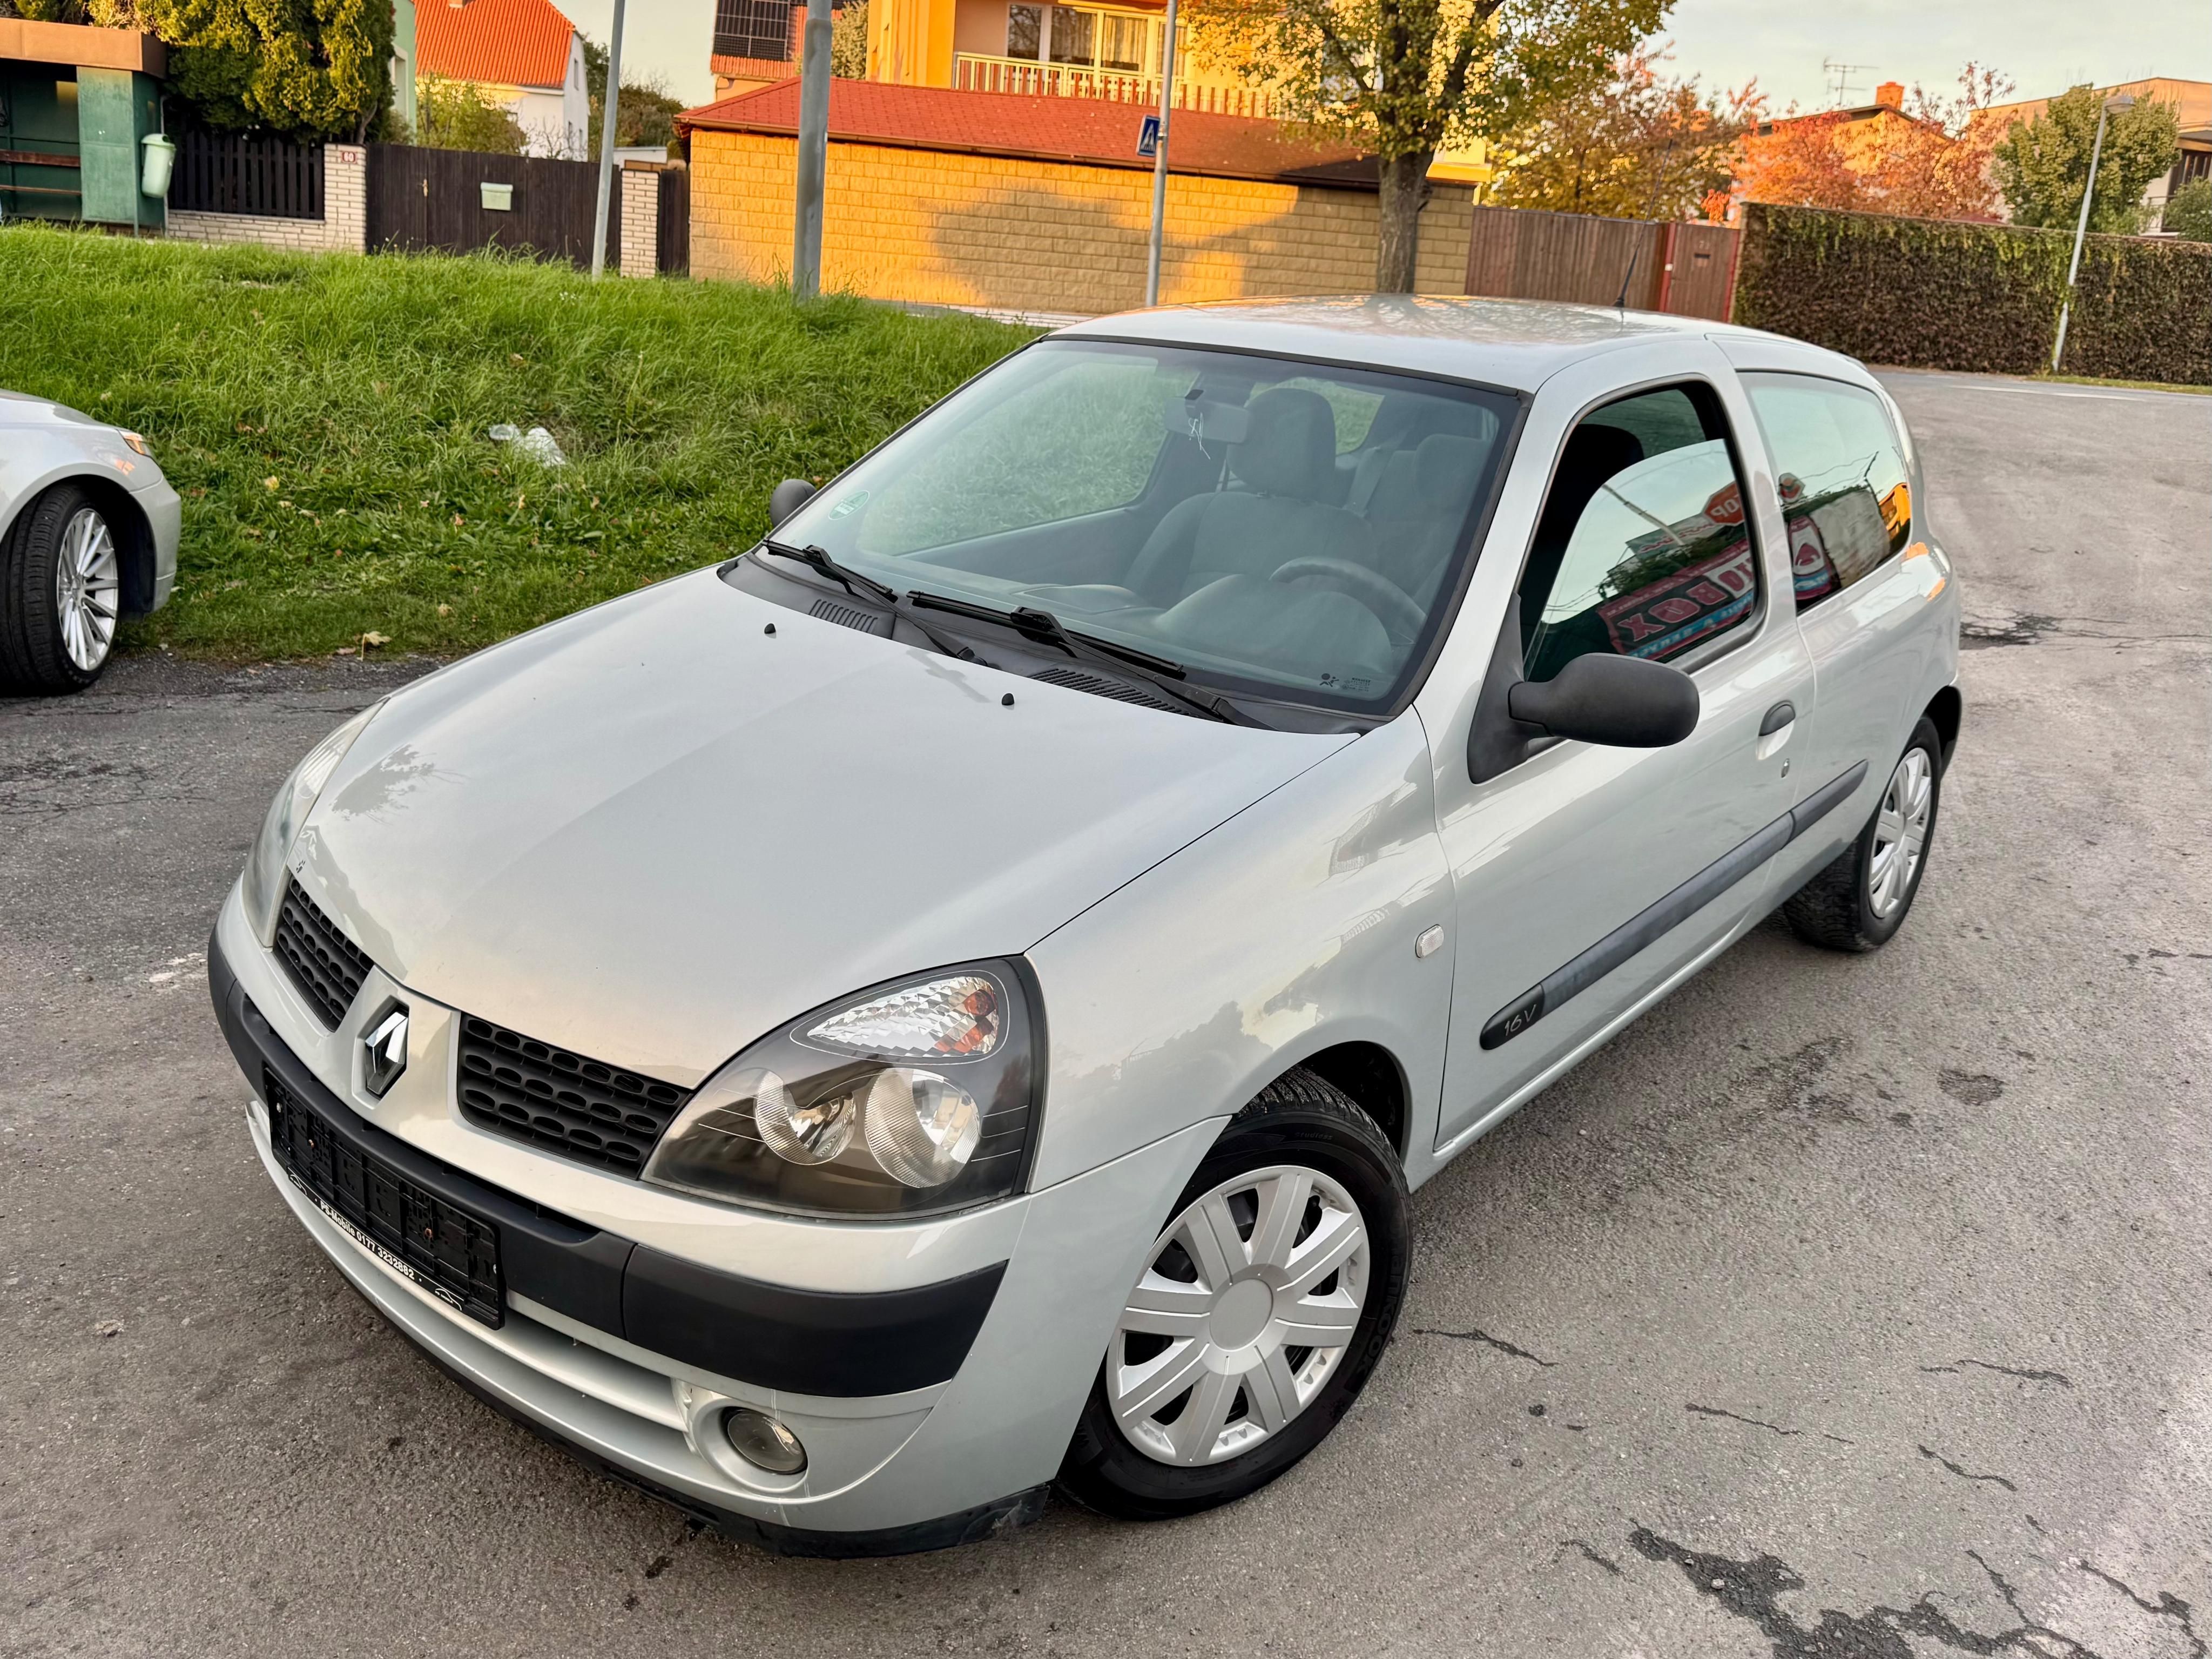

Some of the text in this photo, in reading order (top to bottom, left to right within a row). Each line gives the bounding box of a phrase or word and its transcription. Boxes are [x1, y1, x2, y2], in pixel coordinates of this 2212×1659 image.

[1505, 1004, 1536, 1036] 16V
[320, 1200, 415, 1280] PS-Mobile 0177 3232882
